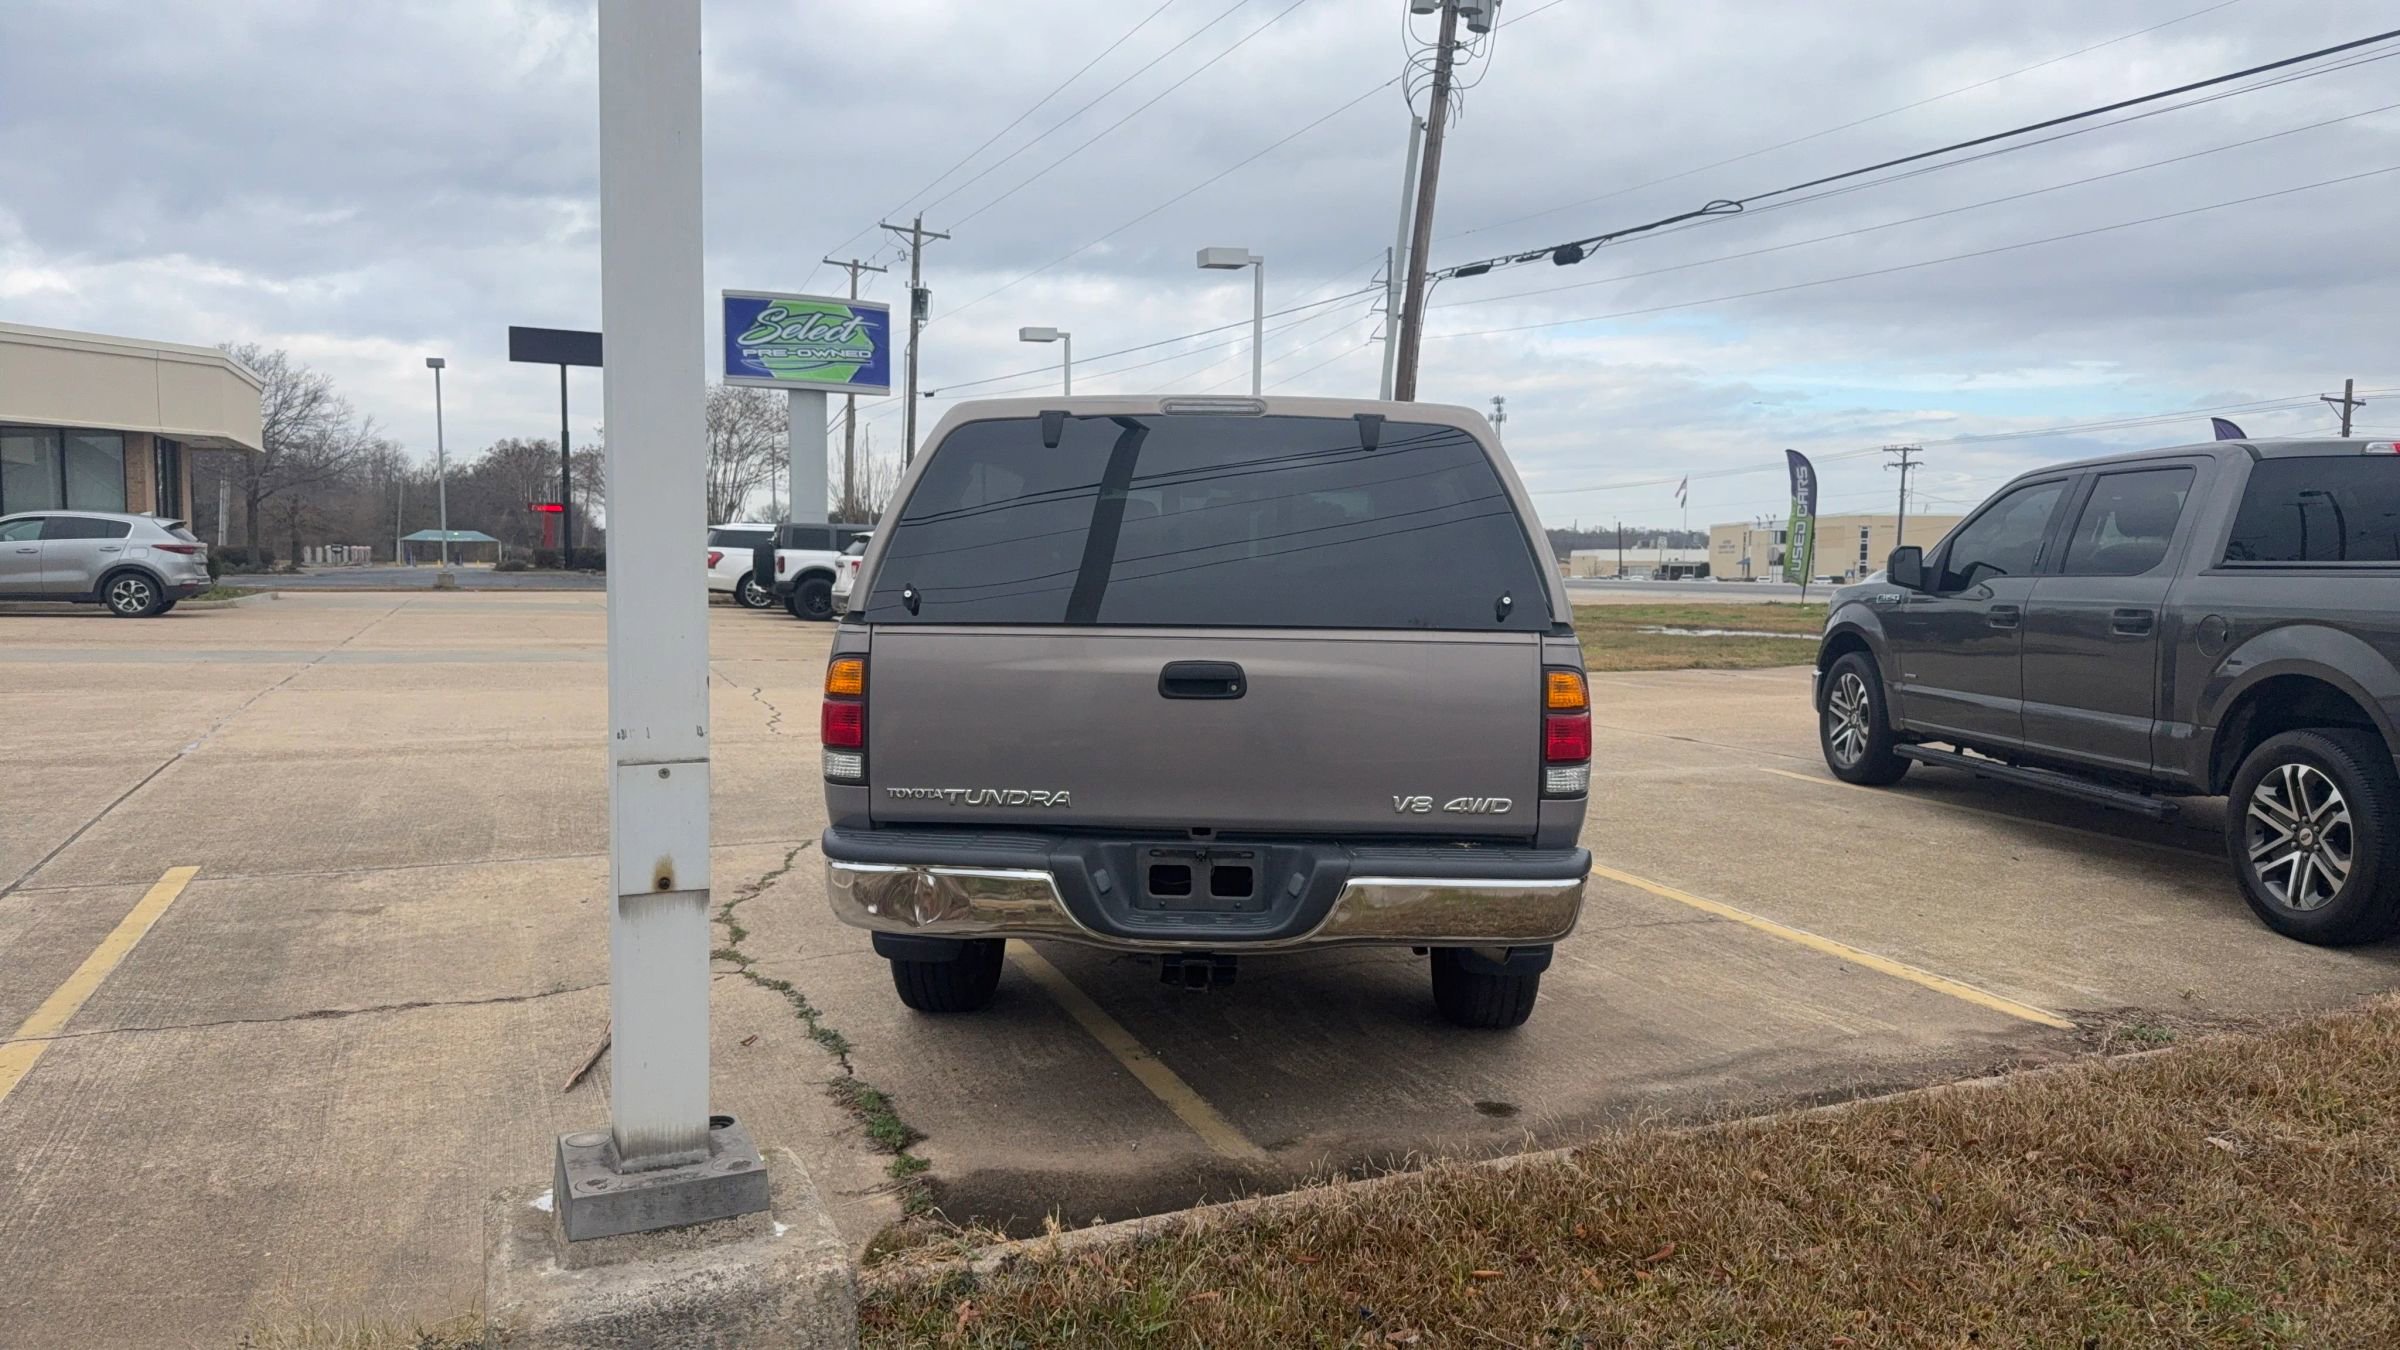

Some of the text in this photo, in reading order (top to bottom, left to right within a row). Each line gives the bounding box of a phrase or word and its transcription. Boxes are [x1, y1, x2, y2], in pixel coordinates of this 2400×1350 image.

[737, 307, 879, 346] Select
[742, 348, 872, 359] PRE-OWNED
[1791, 466, 1809, 571] USED CARS
[887, 788, 1071, 807] TOYOTA TUNDRA
[1393, 796, 1512, 814] V8 4WD
